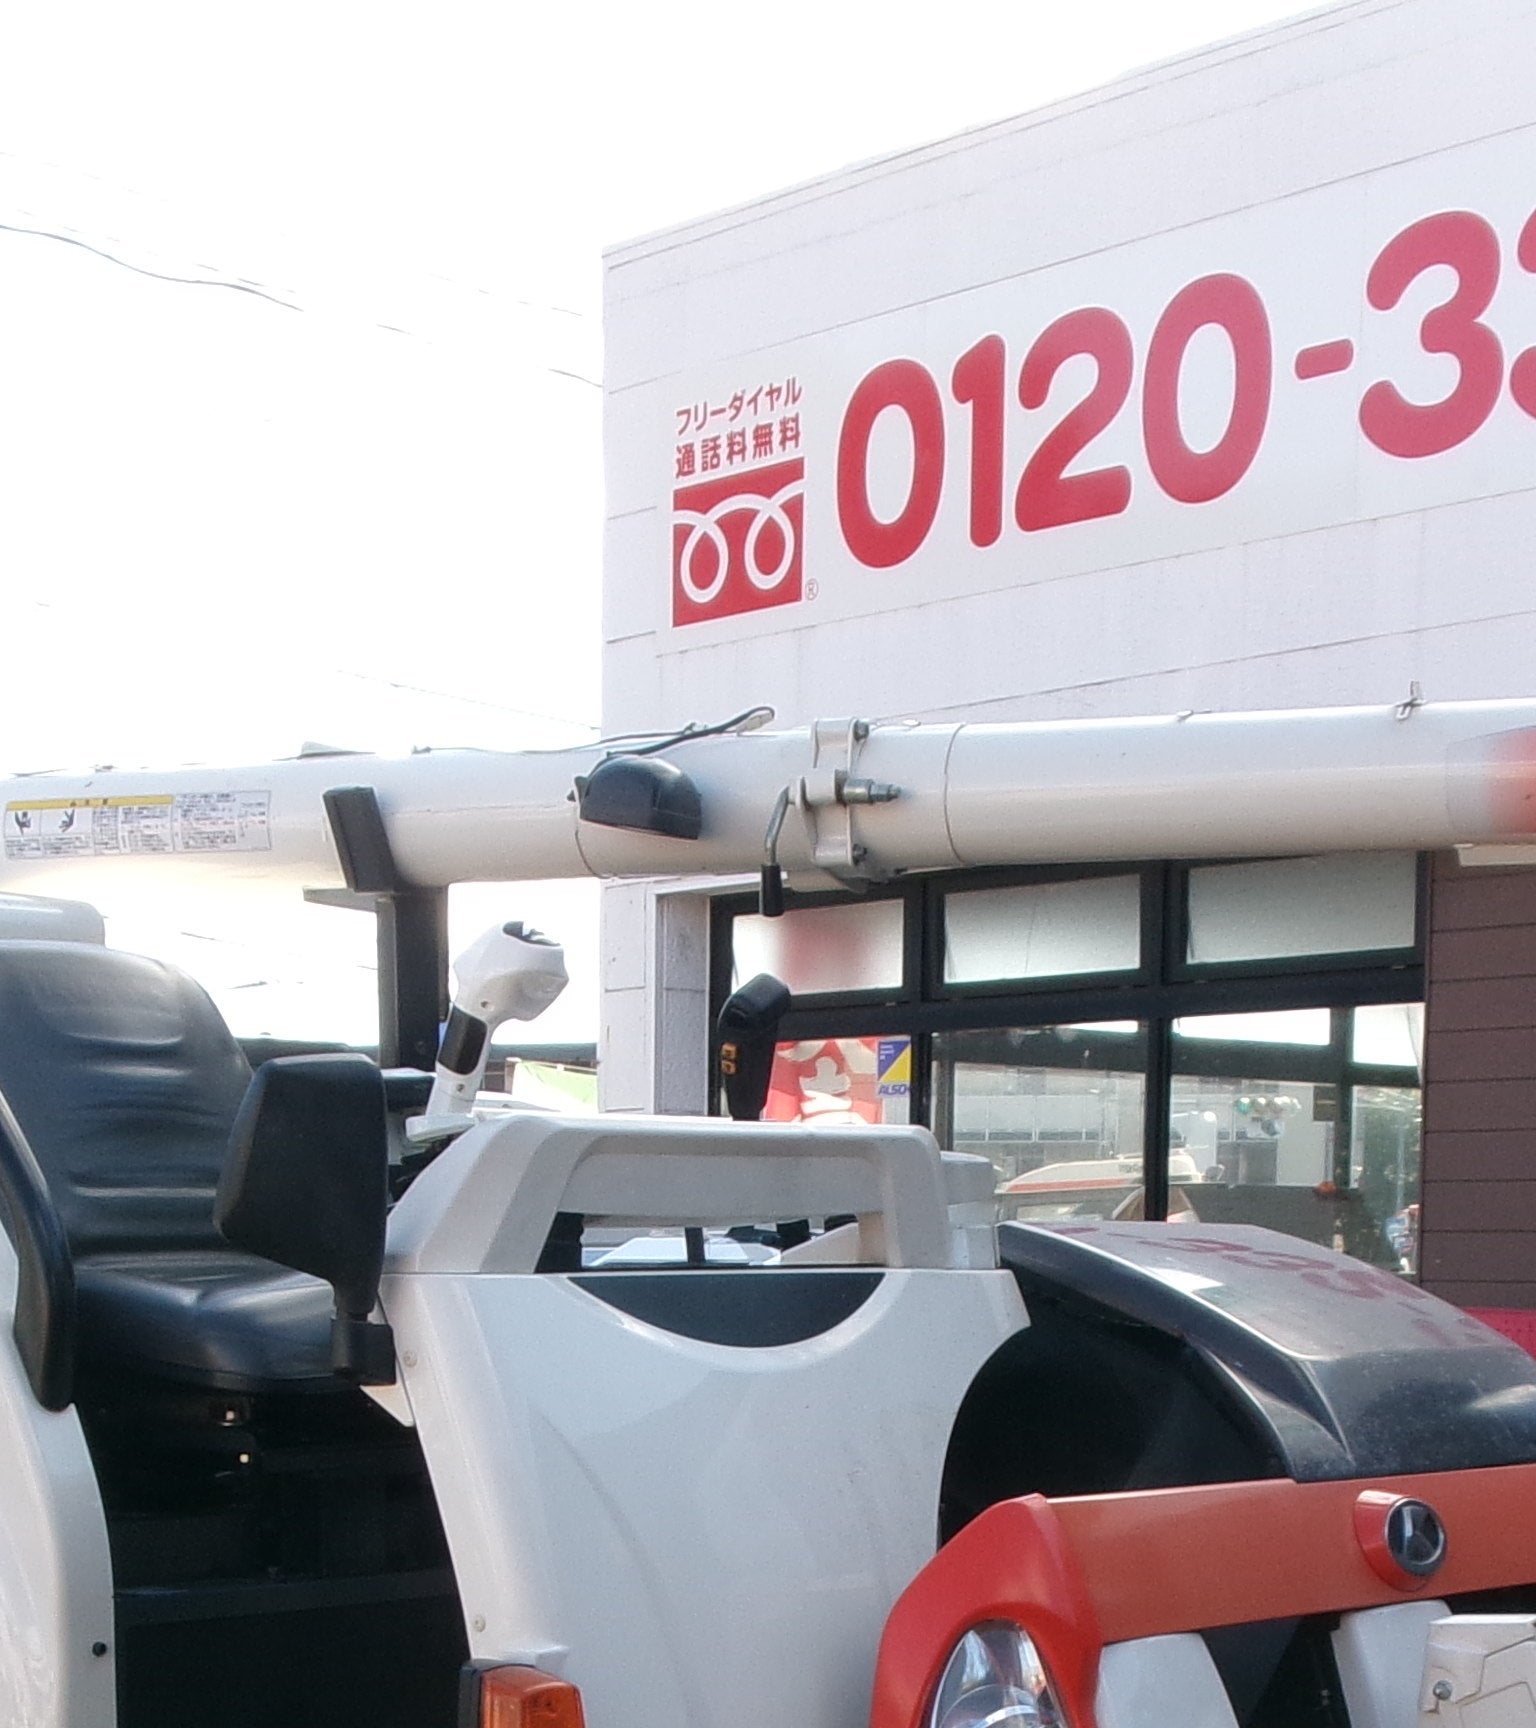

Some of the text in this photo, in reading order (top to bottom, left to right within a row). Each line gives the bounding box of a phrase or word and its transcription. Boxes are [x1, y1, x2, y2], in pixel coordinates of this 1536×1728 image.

[675, 376, 802, 436] フリーダイヤル
[675, 411, 801, 479] 通話料無料
